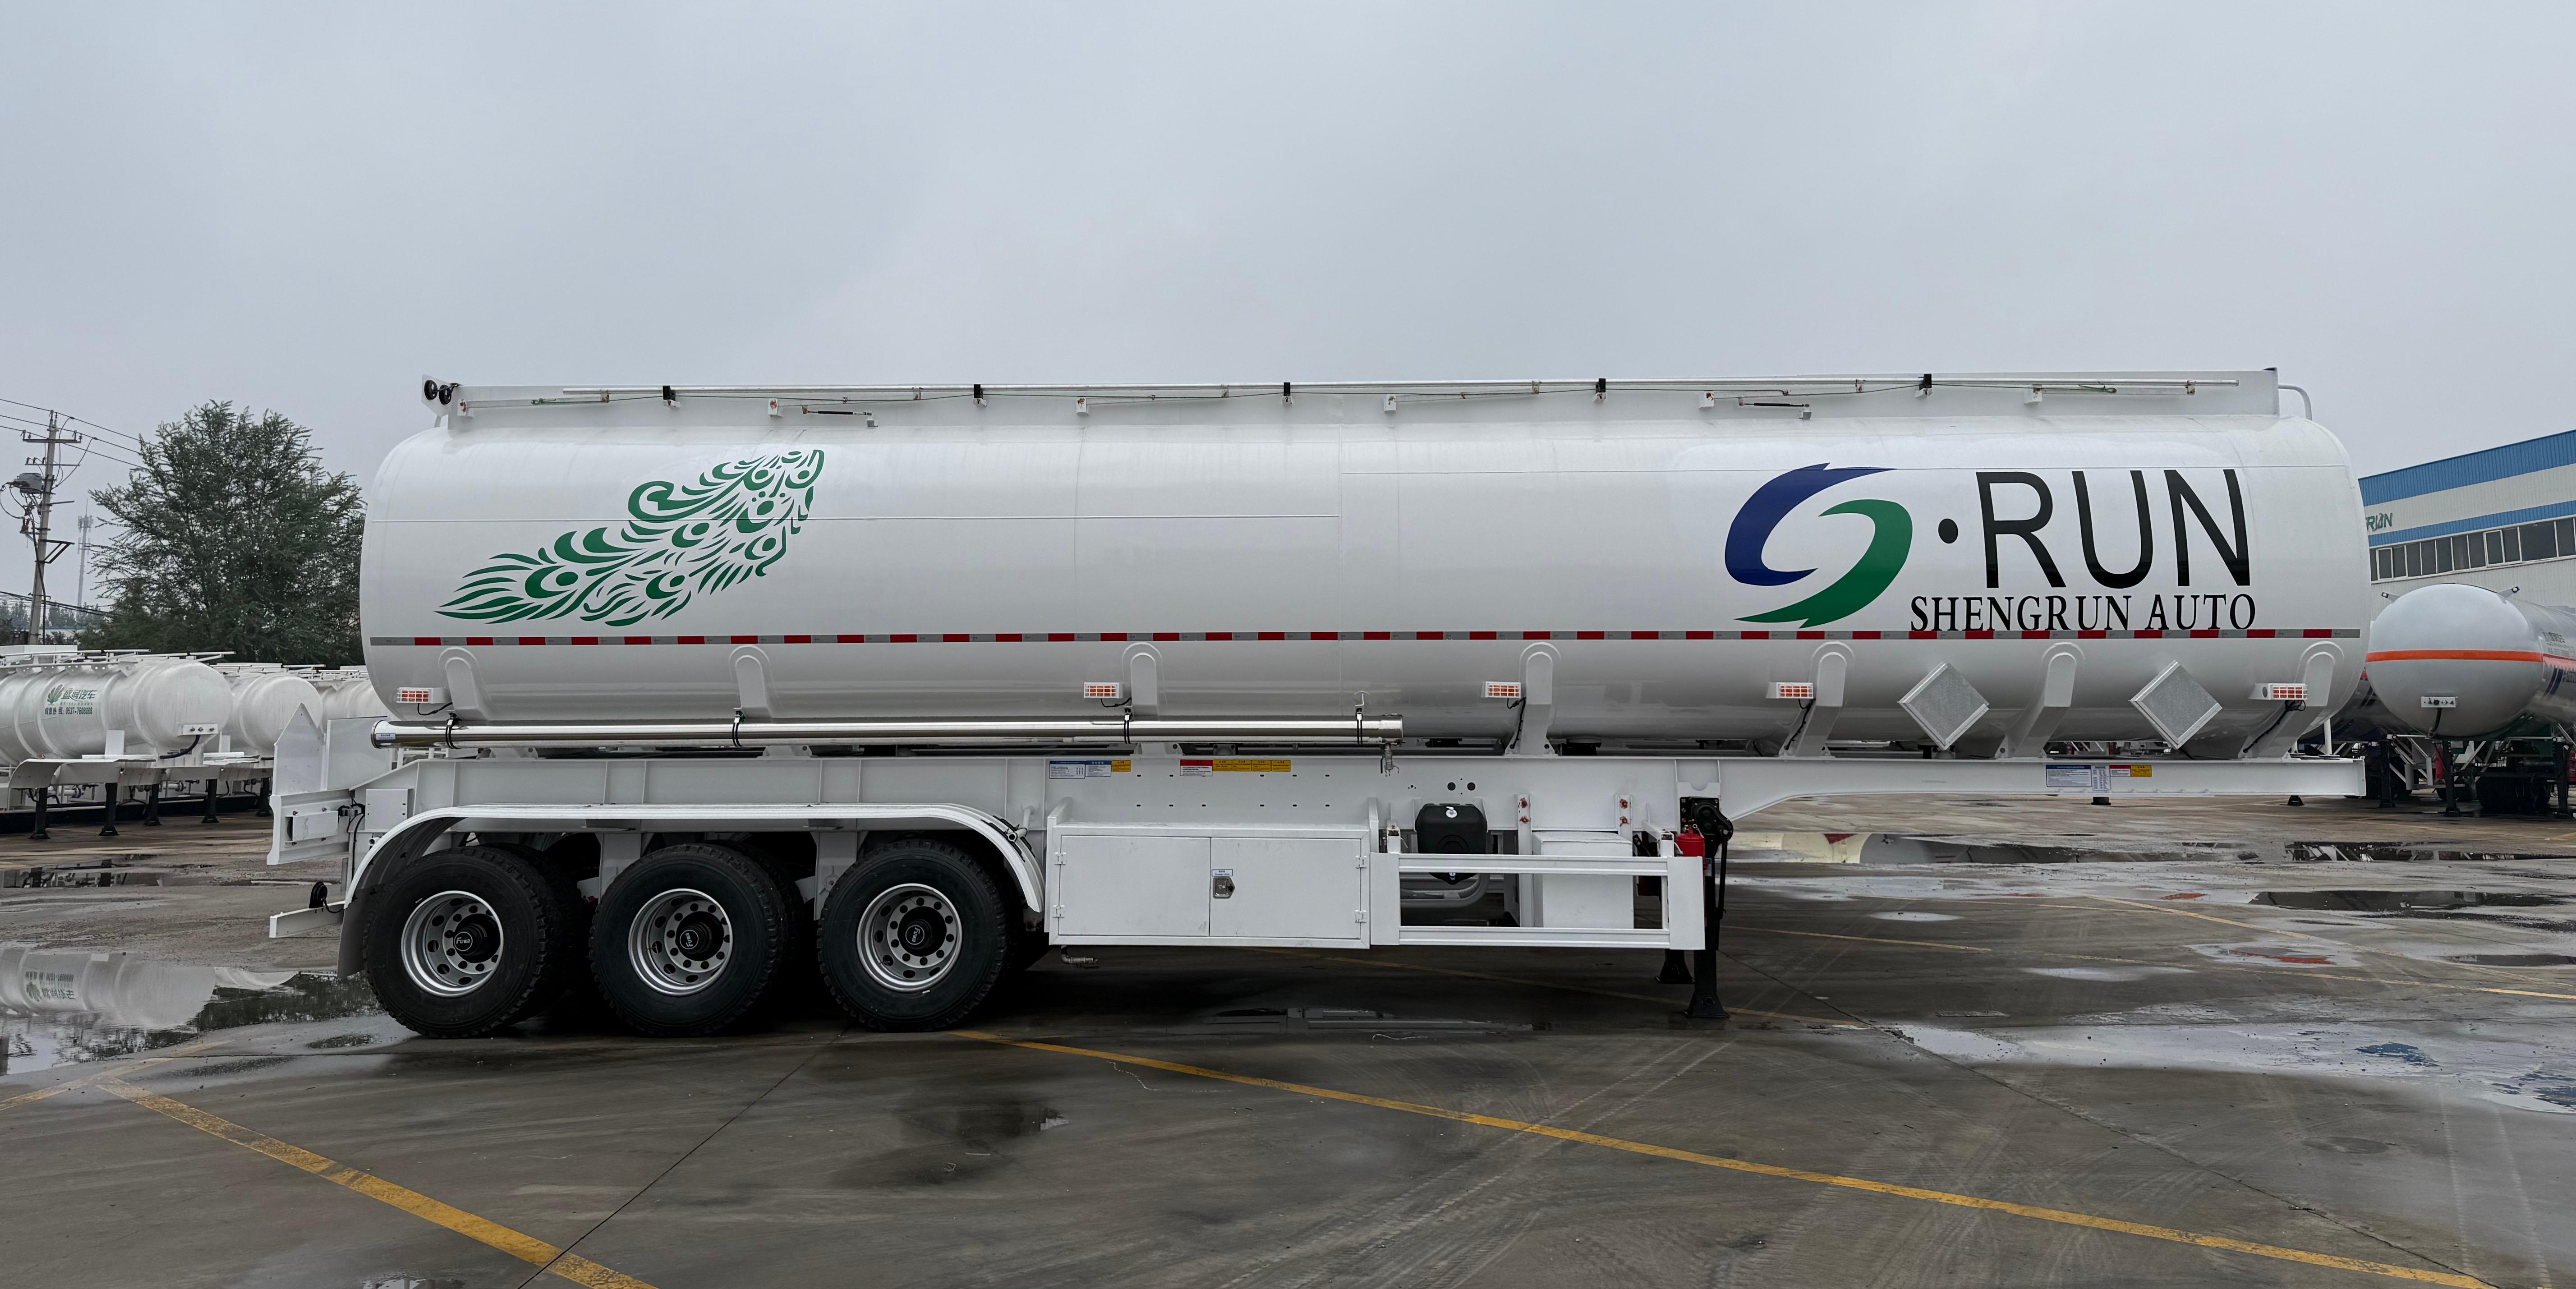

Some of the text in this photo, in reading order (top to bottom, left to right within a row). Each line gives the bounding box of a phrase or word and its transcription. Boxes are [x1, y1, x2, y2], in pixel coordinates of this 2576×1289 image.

[2365, 512, 2392, 531] RUN
[1911, 594, 2255, 631] SHENGRUN AUTO
